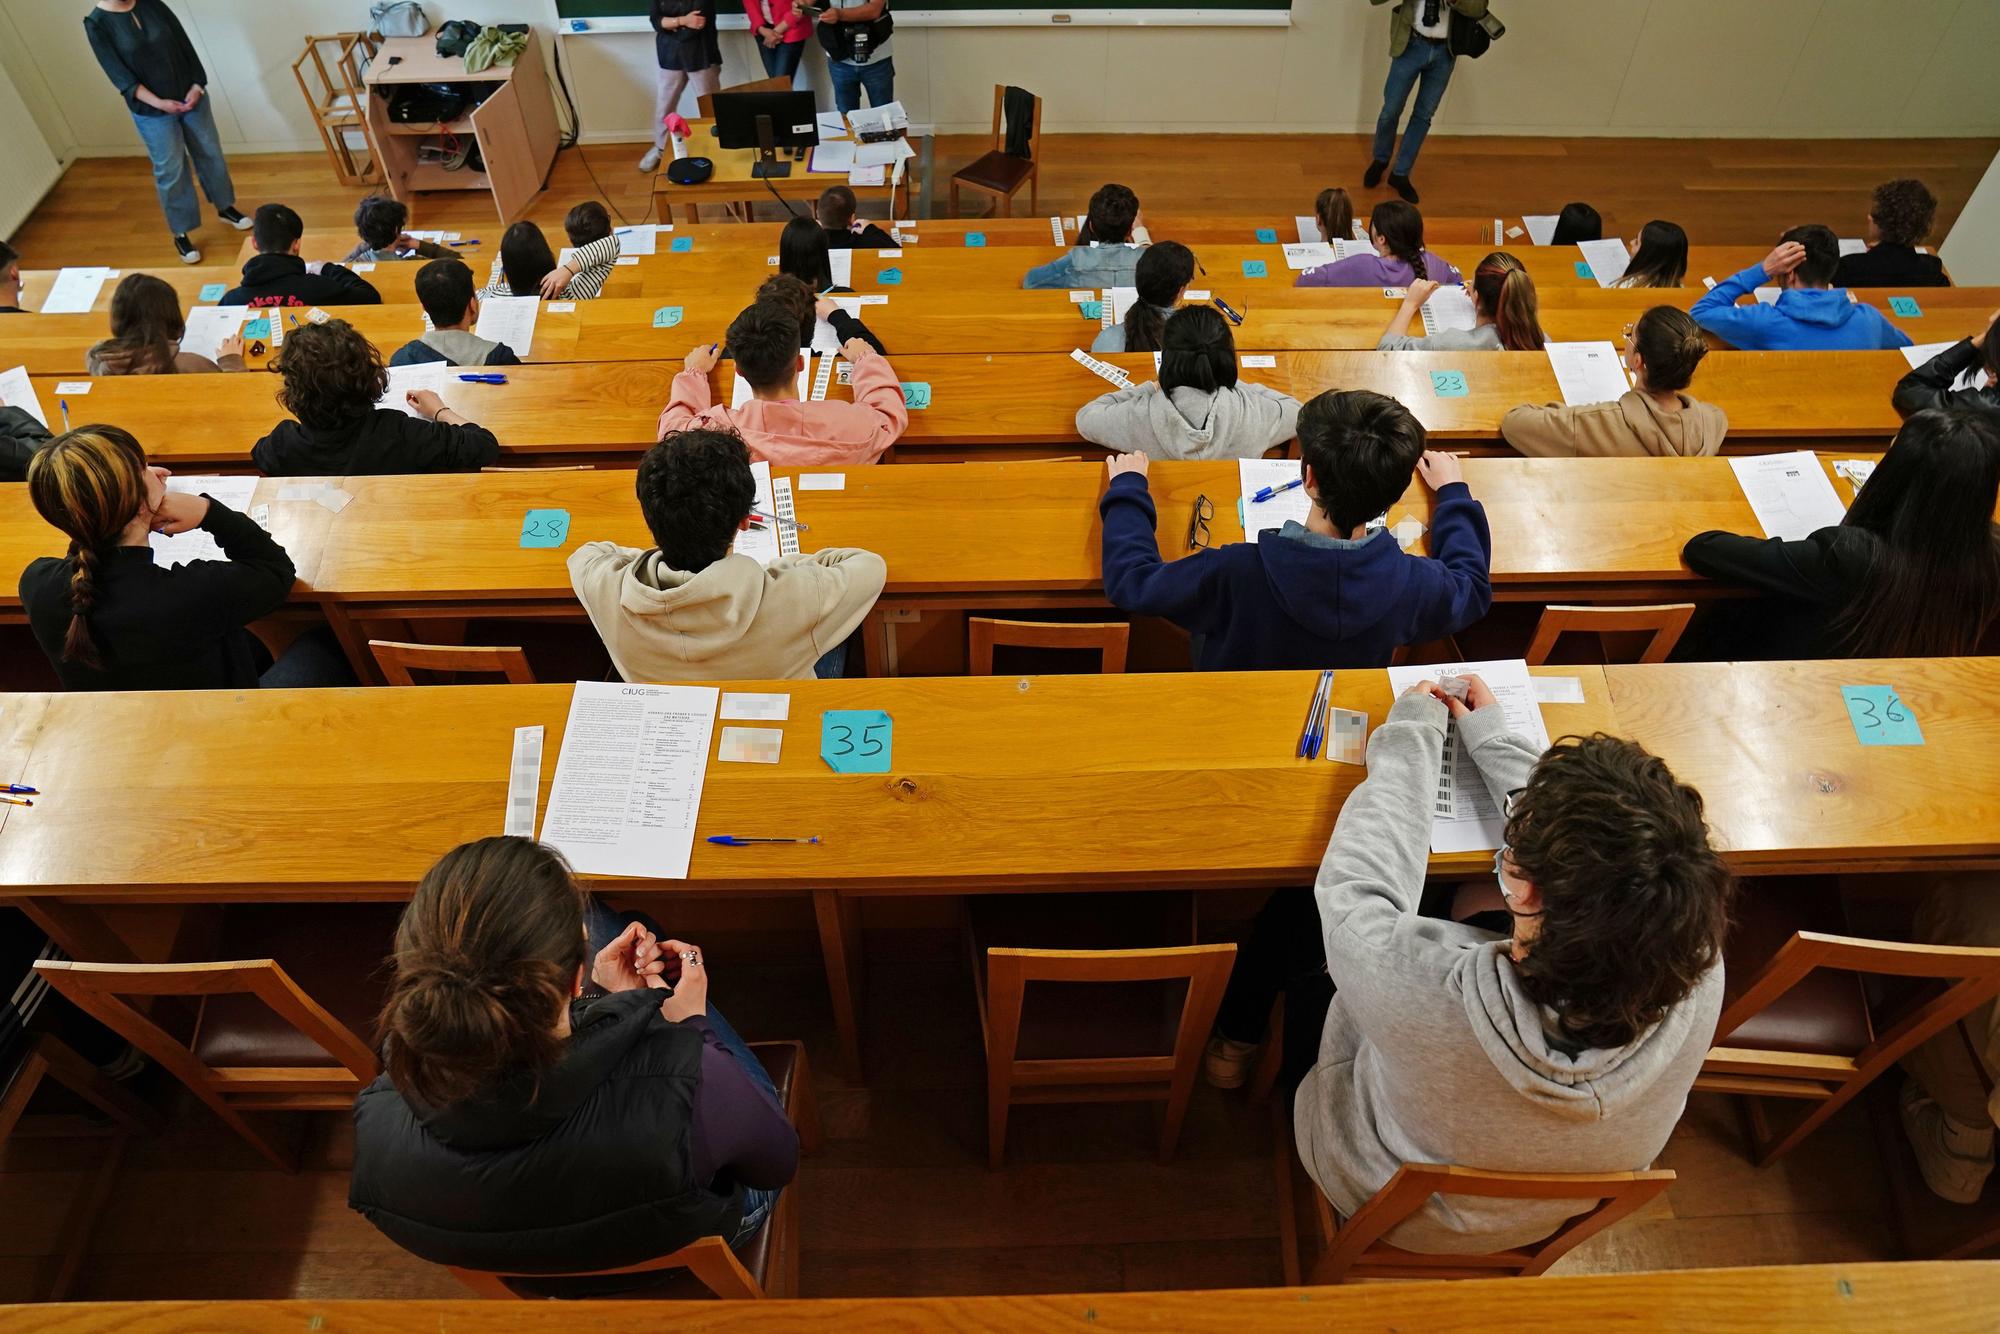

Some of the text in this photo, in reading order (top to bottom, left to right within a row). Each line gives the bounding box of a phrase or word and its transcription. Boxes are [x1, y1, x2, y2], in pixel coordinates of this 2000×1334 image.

[1246, 263, 1265, 274] 10
[655, 310, 682, 324] 15
[245, 321, 268, 335] 14
[1434, 375, 1463, 391] 23
[904, 388, 928, 406] 22
[521, 519, 564, 539] 28
[1434, 667, 1458, 676] CIUG
[621, 687, 646, 696] CIUG
[1850, 697, 1905, 729] 36
[830, 724, 887, 757] 35
